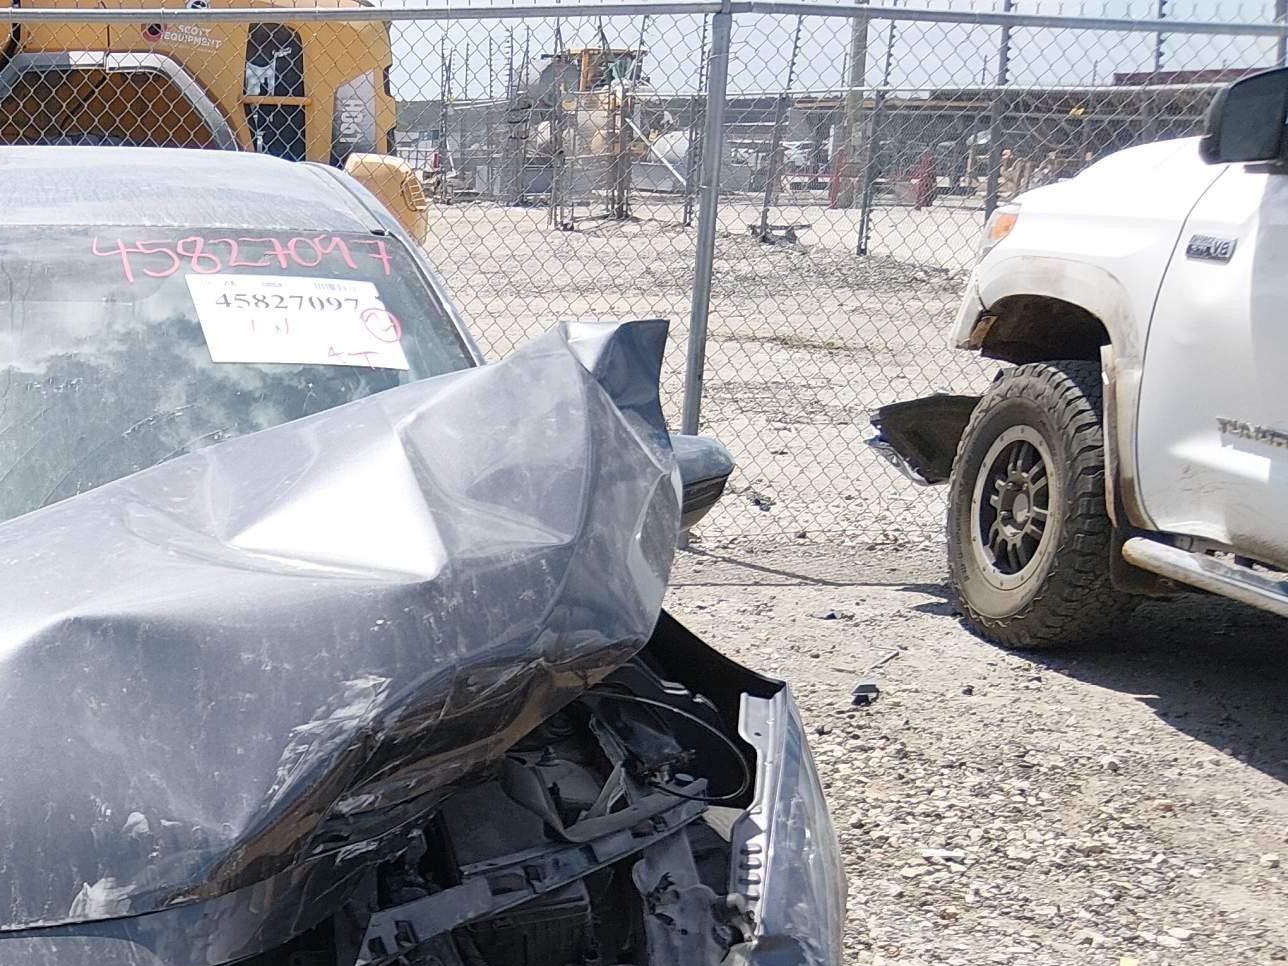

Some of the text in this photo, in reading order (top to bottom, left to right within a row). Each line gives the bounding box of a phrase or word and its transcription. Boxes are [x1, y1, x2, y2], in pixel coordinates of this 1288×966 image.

[177, 24, 211, 37] SCOTT
[164, 32, 222, 48] EQUIPMENT
[92, 235, 392, 282] 45827097
[216, 293, 360, 312] 45827097
